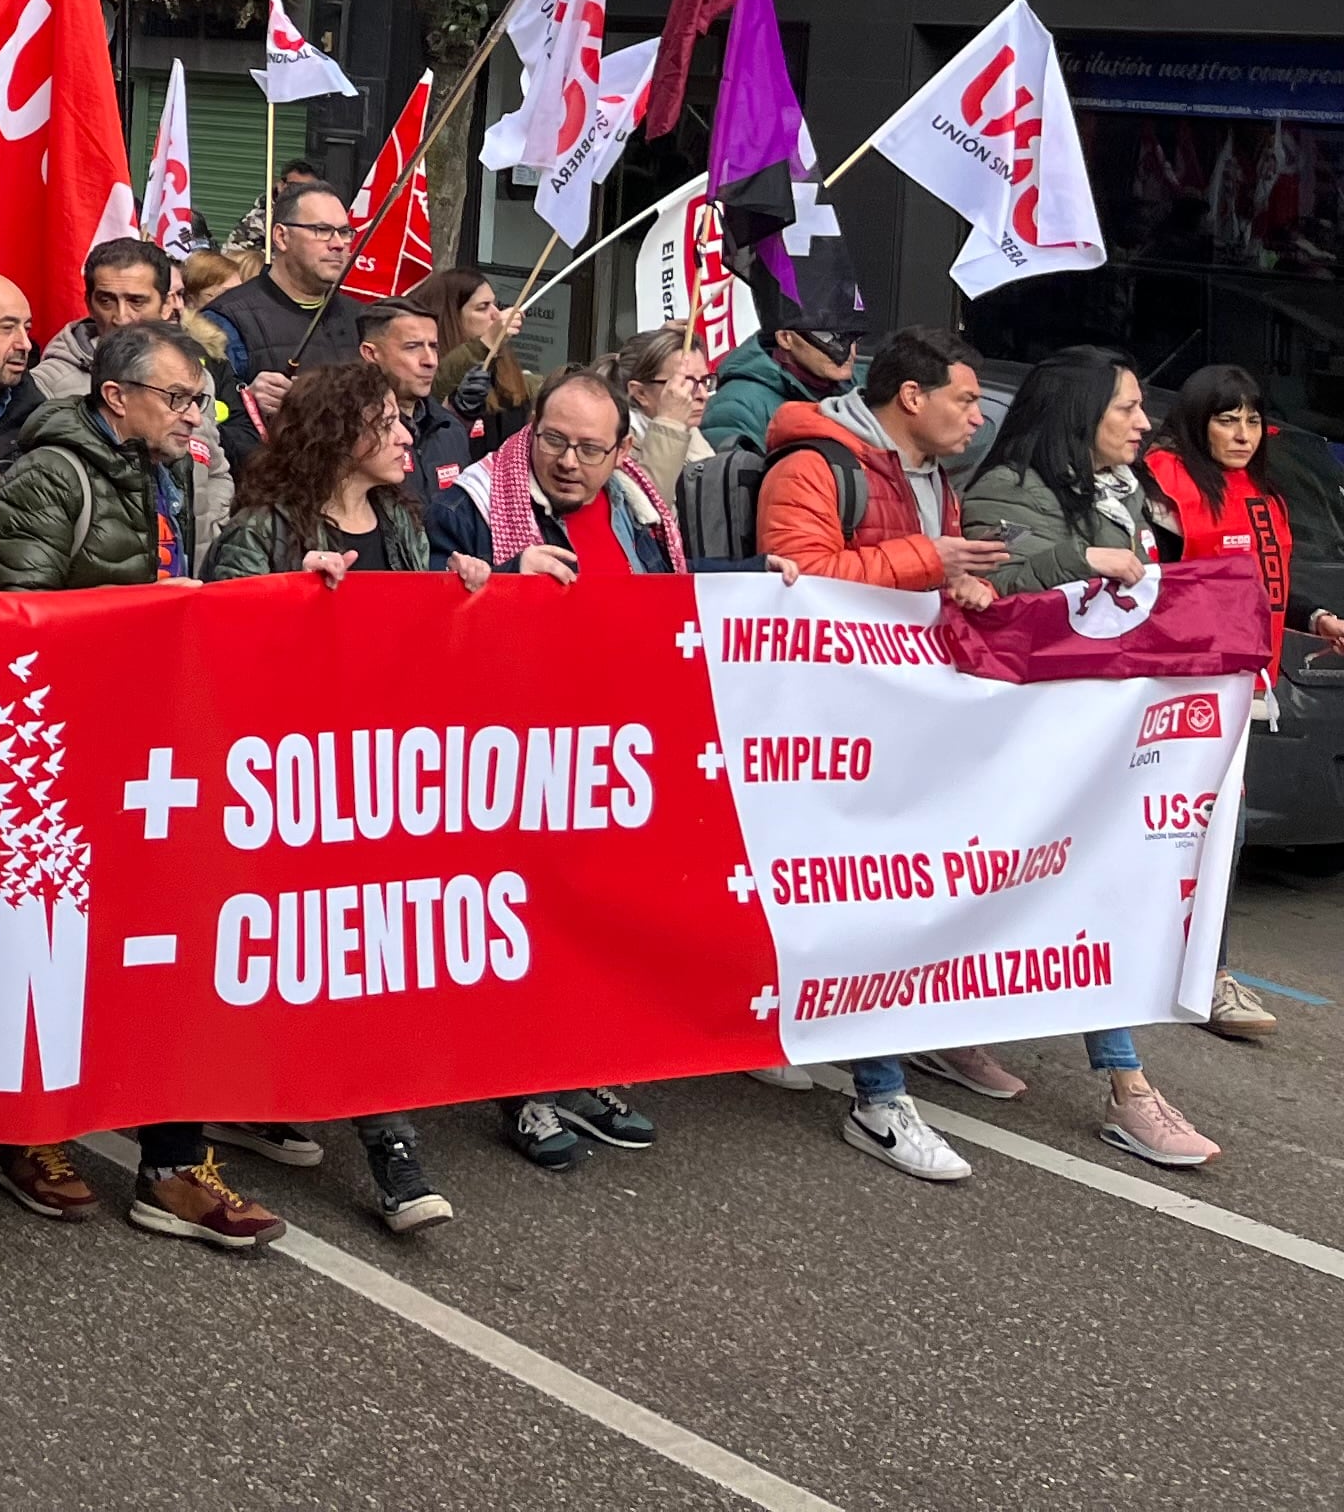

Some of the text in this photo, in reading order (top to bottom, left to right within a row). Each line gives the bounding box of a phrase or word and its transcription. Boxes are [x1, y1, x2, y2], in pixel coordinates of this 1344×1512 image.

[932, 114, 992, 163] UNIÓN
[662, 240, 674, 262] El
[1252, 504, 1282, 605] CCOO
[1142, 702, 1185, 738] UGT
[223, 723, 654, 850] SOLUCIONES
[743, 737, 872, 783] EMPLEO
[1129, 749, 1160, 769] León
[771, 853, 935, 906] SERVICIOS
[943, 835, 1072, 898] PÚBLICOS
[214, 870, 531, 1007] CUENTOS
[794, 929, 1112, 1021] REINDUSTRIALIZACIÓN
